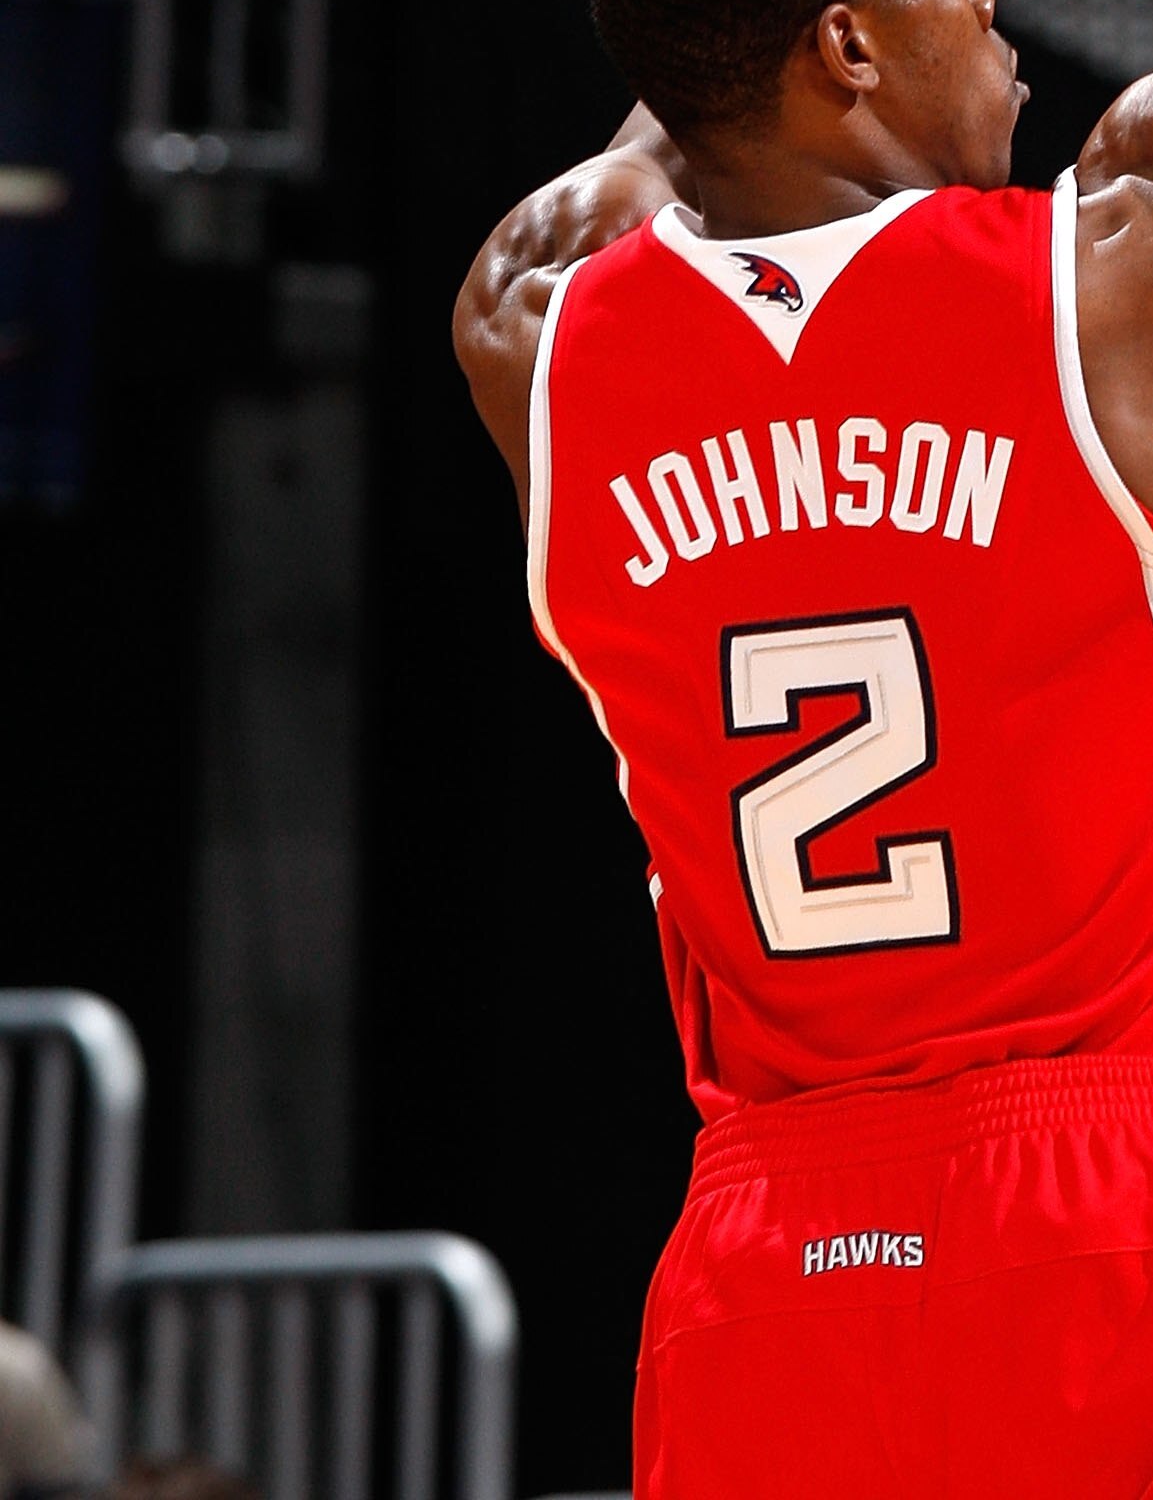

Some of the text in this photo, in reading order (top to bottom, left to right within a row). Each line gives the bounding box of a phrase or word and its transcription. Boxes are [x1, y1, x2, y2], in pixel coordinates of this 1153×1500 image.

[609, 417, 1015, 588] JOHNSON
[719, 606, 961, 961] 2
[802, 1230, 925, 1277] HAWKS
